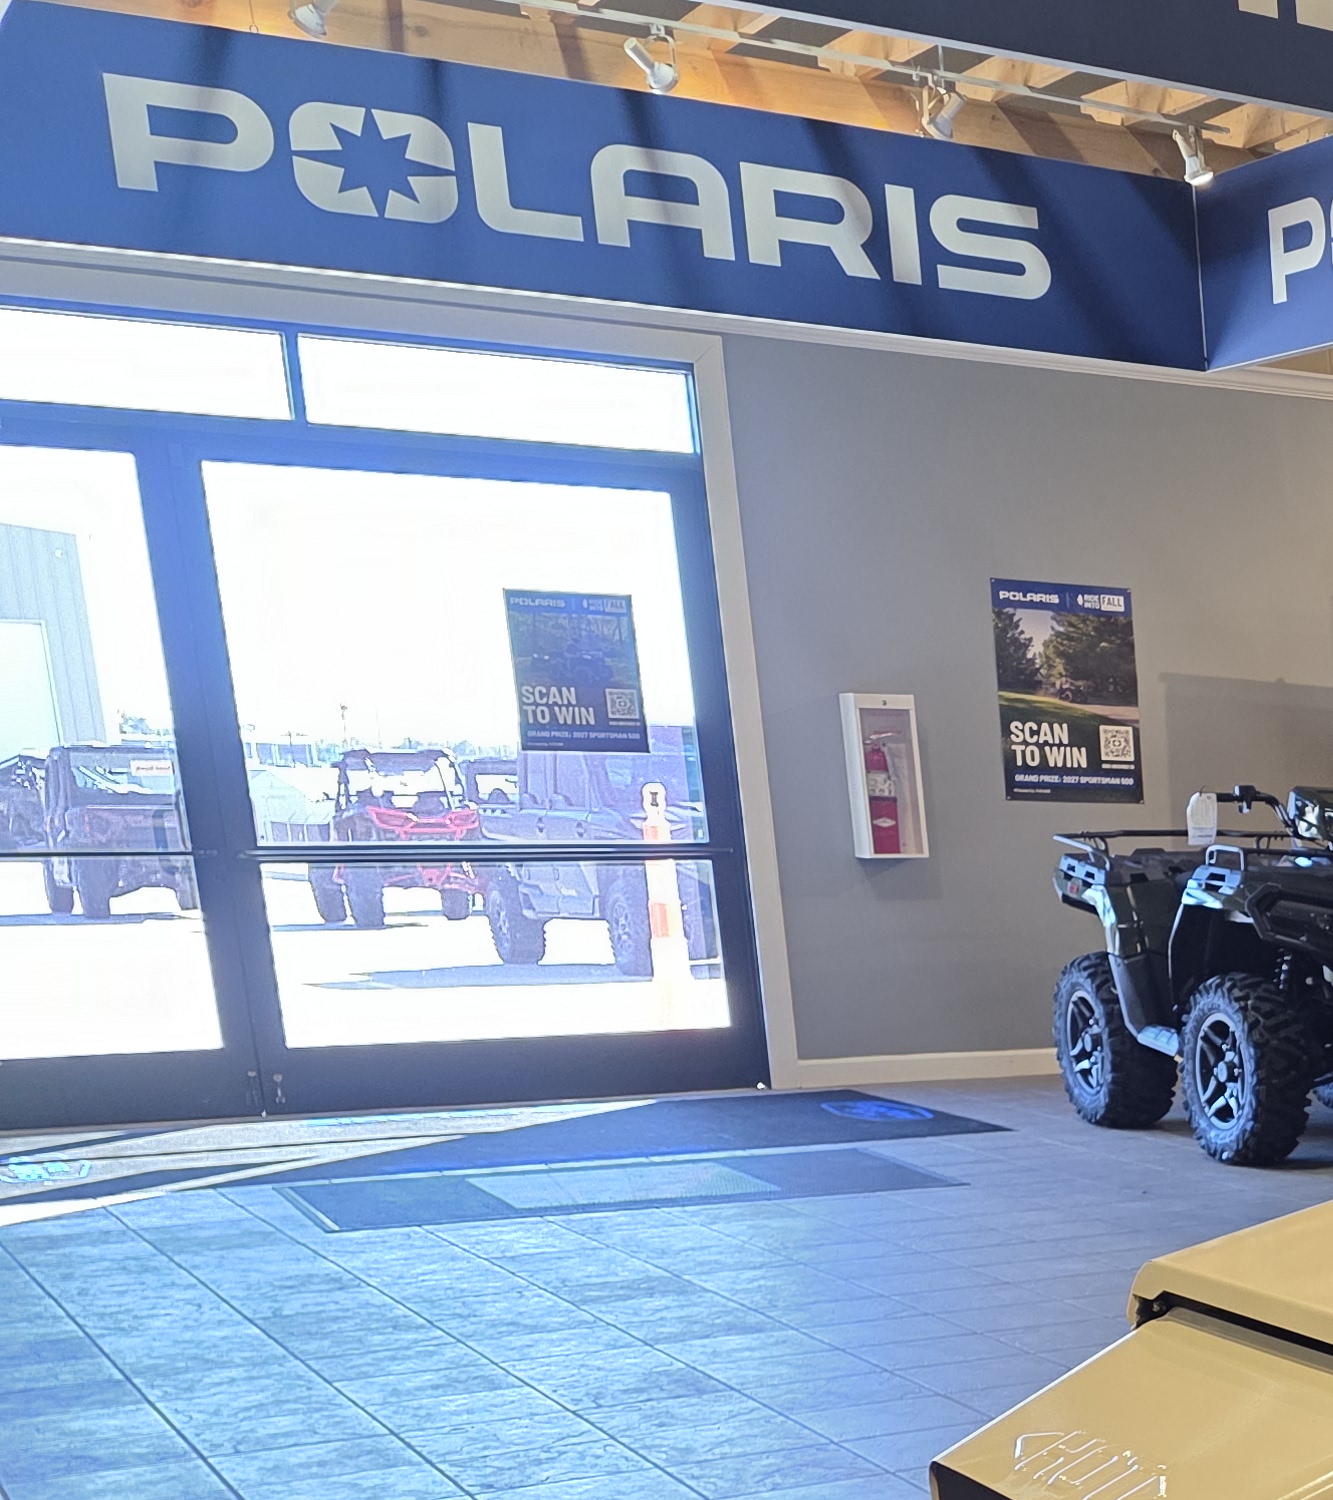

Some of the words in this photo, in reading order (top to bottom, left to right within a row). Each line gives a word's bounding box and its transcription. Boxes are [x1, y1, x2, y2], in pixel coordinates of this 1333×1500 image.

[102, 72, 1052, 300] POLARIS
[510, 596, 566, 608] POLARIS
[999, 590, 1060, 604] POLARIS
[521, 686, 577, 706] SCAN
[523, 705, 550, 724] TO
[553, 706, 595, 726] WIN
[1009, 721, 1070, 745] SCAN
[1011, 744, 1041, 767] TO
[1044, 746, 1088, 769] WIN
